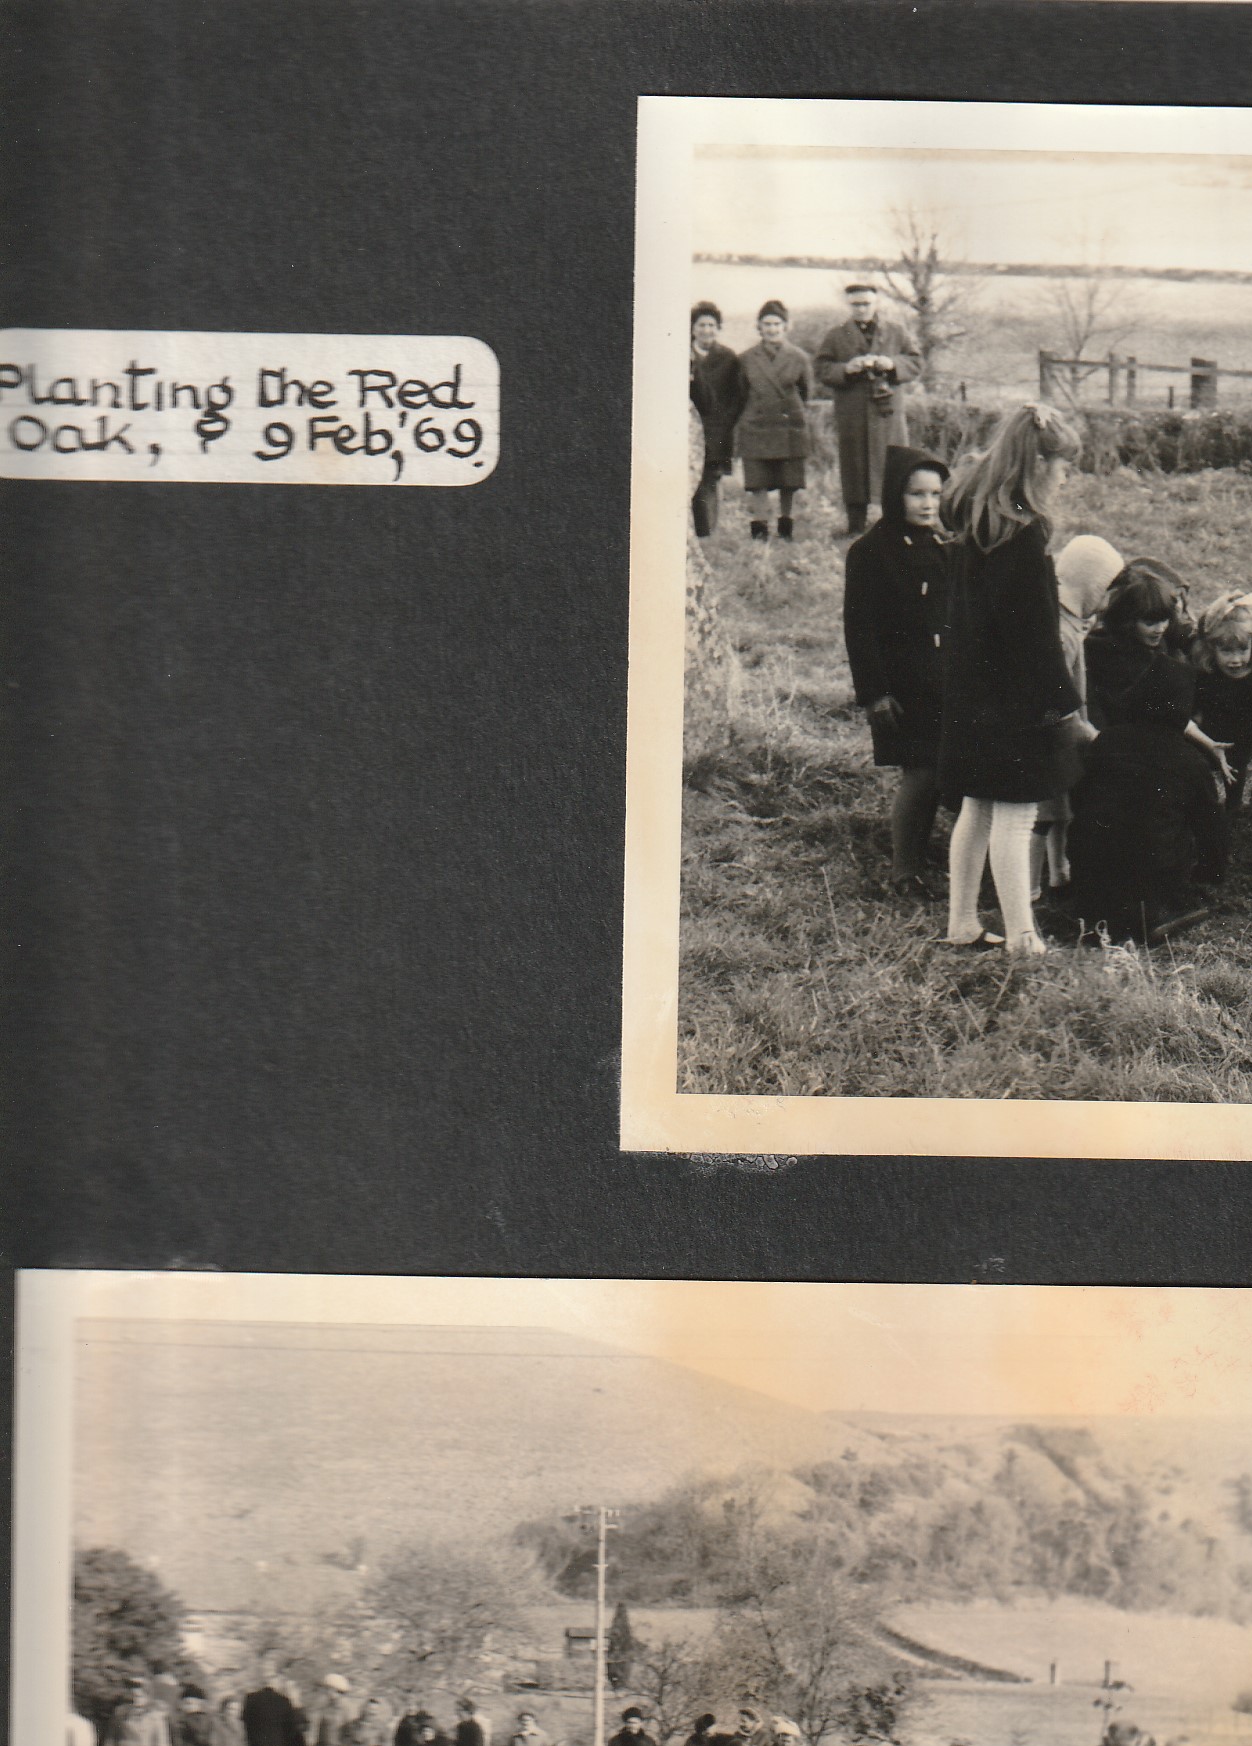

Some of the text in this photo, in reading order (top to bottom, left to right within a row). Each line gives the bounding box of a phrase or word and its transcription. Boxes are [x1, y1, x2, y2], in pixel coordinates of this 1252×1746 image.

[0, 359, 476, 442] Planting the Red
[7, 414, 164, 467] Oak,
[253, 421, 296, 462] 9
